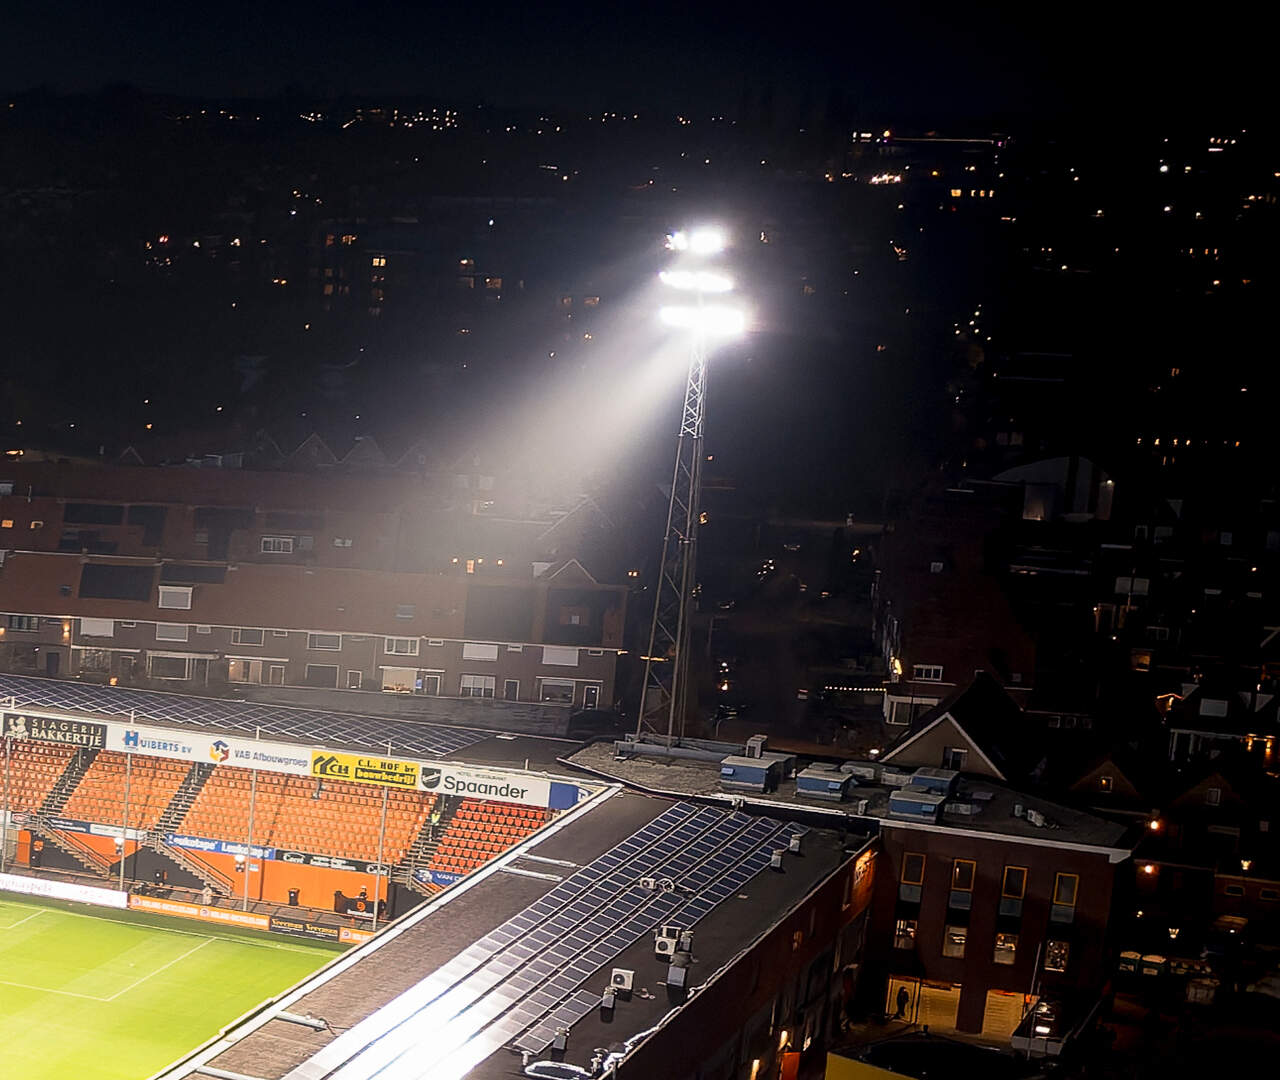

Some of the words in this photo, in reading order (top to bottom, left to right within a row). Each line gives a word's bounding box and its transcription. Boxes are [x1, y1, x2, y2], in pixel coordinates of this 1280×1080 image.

[31, 718, 103, 736] SLAGERIJ
[31, 728, 102, 747] BAKKERTJE
[252, 751, 308, 767] Afbouwgroep
[357, 759, 376, 769] C.L.
[380, 761, 400, 771] HOF
[443, 775, 528, 799] Spaander
[436, 872, 455, 880] VAN
